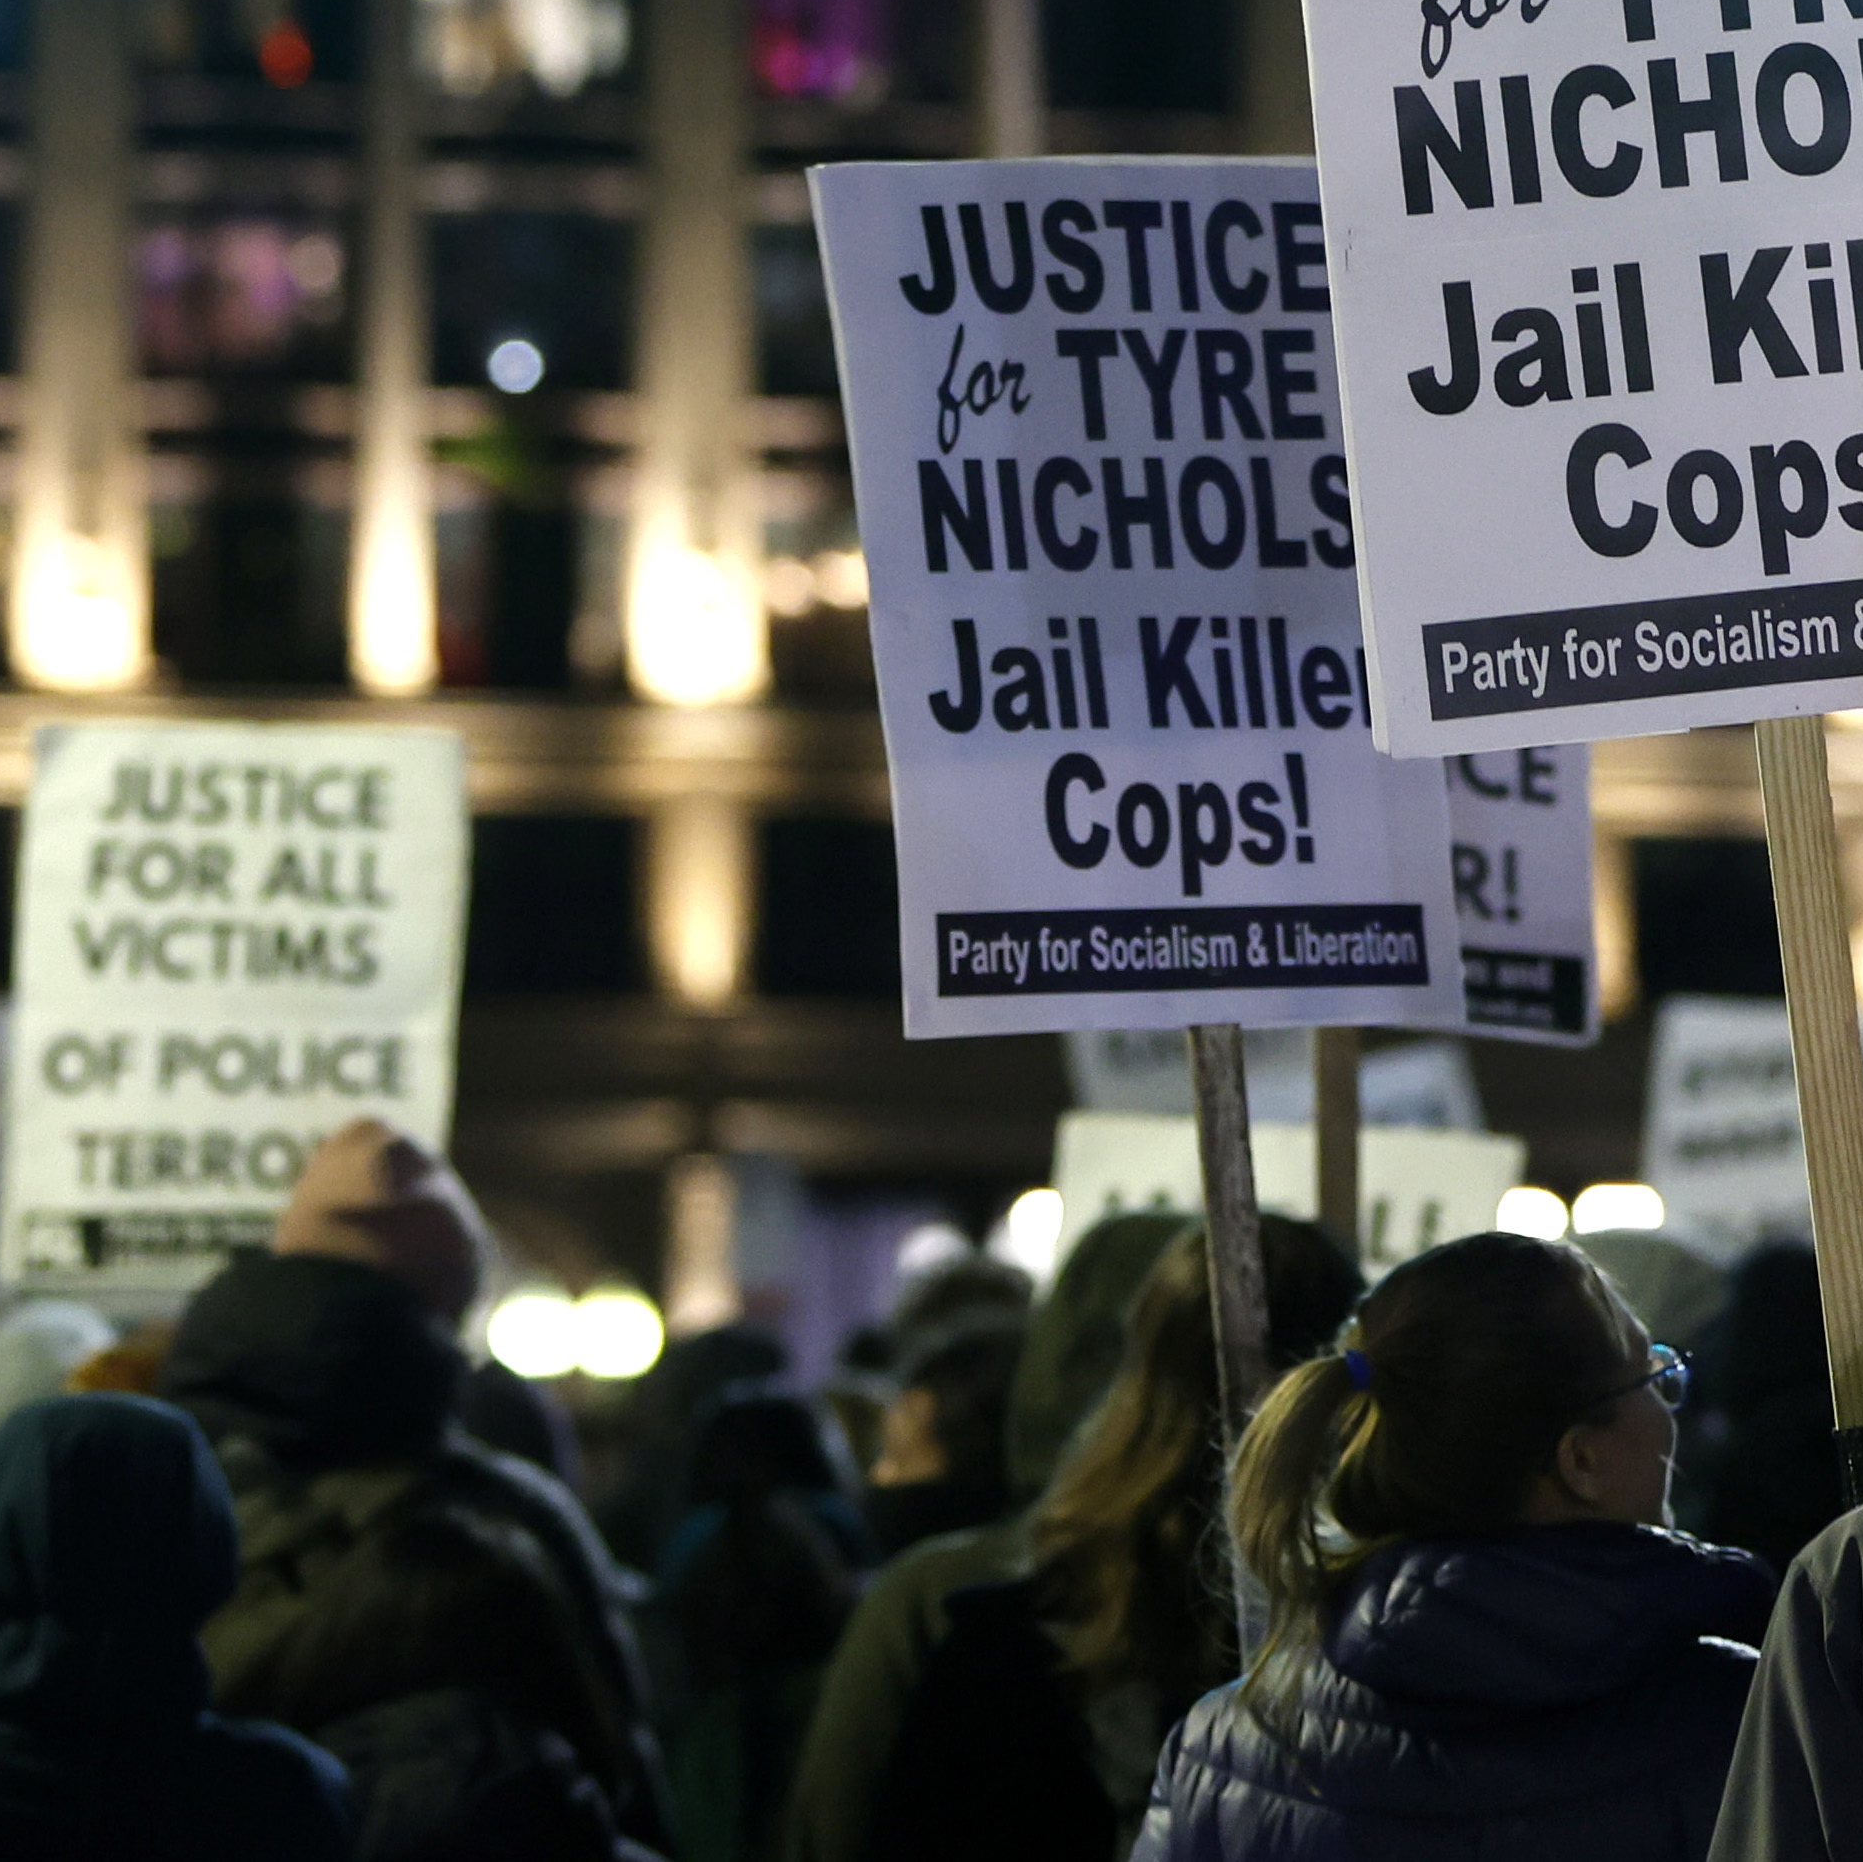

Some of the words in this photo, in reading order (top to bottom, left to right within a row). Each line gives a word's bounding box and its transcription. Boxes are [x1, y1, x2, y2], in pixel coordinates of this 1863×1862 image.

[898, 199, 1331, 315] JUSTICE
[1407, 260, 1655, 416] Jail
[936, 323, 1033, 453] for
[1055, 328, 1325, 442] TYRE
[918, 455, 1357, 574] NICHOLS
[927, 616, 1109, 734] Jail
[1442, 640, 1549, 698] Party
[1562, 629, 1622, 680] for
[1636, 611, 1839, 673] Socialism
[102, 762, 391, 830] JUSTICE
[1044, 751, 1316, 897] Cops!
[85, 840, 236, 903] FOR
[260, 846, 392, 909] ALL
[72, 915, 380, 987] VICTIMS
[948, 930, 1030, 984] Party
[1039, 927, 1082, 973] for
[1090, 925, 1237, 972] Socialism
[1247, 922, 1270, 967] &
[1276, 921, 1419, 967] Liberation
[42, 1031, 132, 1097] OF
[158, 1034, 409, 1099] POLICE
[75, 1130, 312, 1192] TERRO
